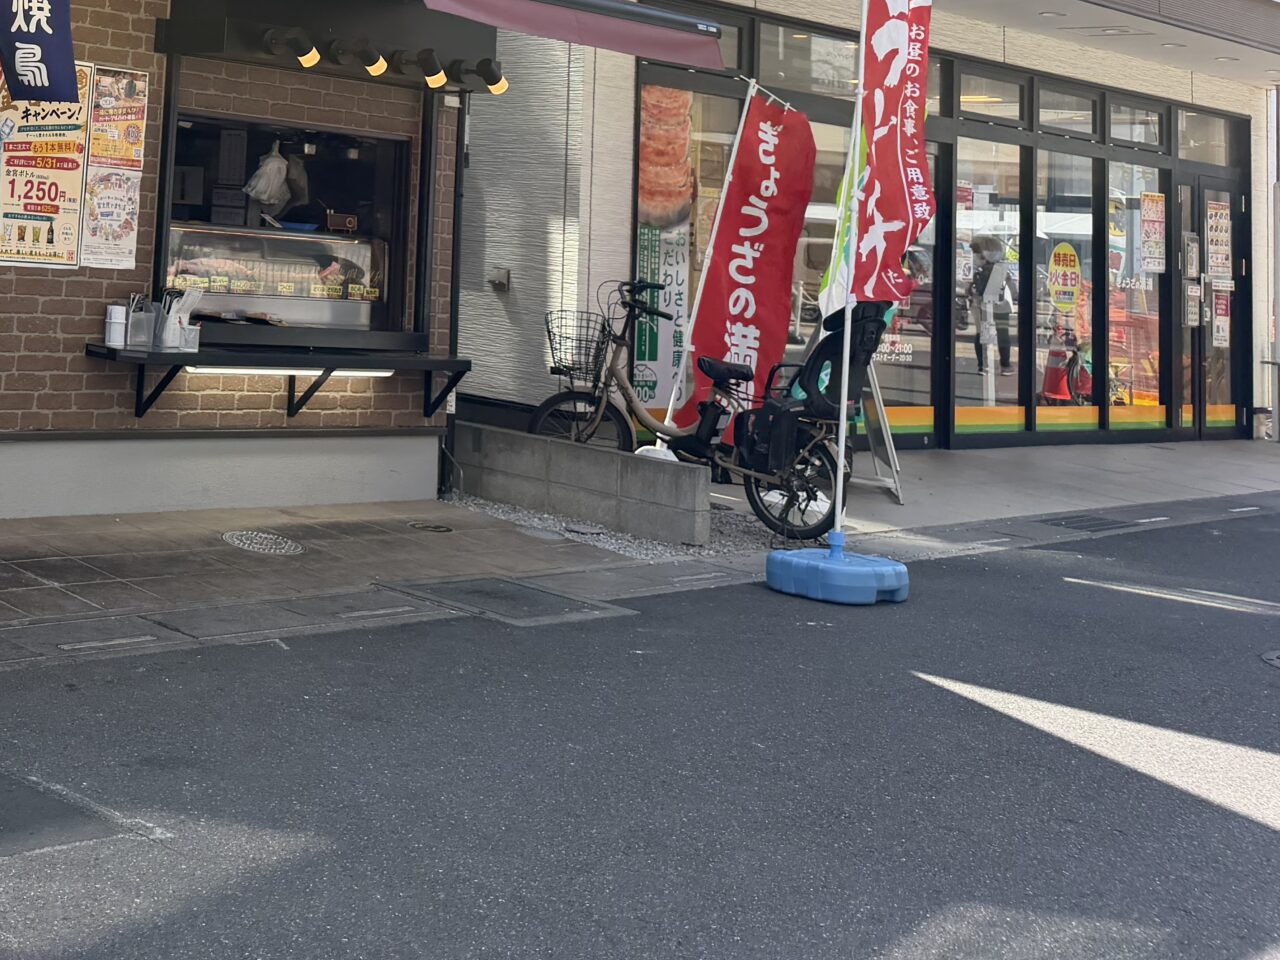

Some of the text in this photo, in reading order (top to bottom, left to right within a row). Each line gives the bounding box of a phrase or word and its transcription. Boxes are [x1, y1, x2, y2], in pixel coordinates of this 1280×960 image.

[21, 105, 83, 124] キャンペーン!
[32, 141, 76, 153] もう1本無料!
[8, 178, 67, 203] 1,250円
[662, 230, 674, 308] こだわり
[1053, 252, 1076, 267] 特売日
